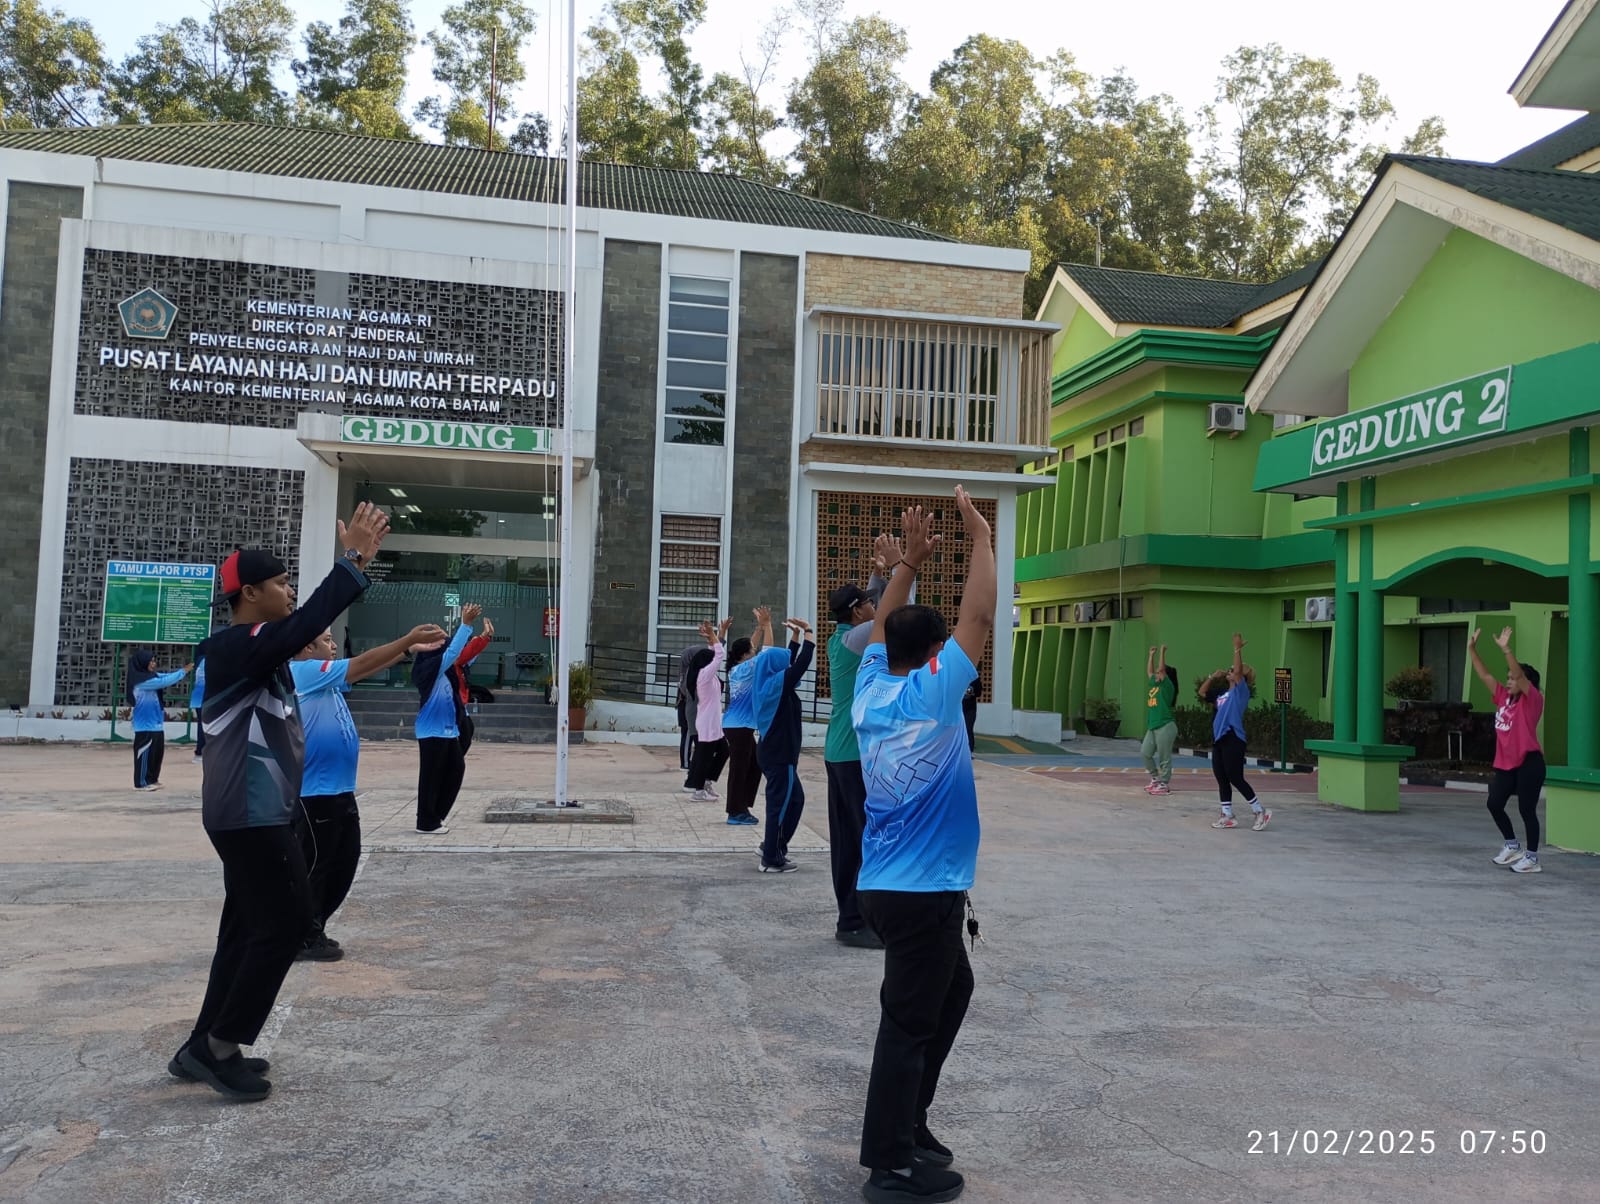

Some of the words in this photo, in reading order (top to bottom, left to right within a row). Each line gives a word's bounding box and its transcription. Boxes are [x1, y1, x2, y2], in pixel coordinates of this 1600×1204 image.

[247, 300, 352, 321] KEMENTERIAN
[358, 310, 412, 327] AGAMA
[417, 314, 432, 328] RI
[252, 319, 345, 338] DIREKTORAT
[351, 327, 425, 344] JENDERAL
[189, 332, 341, 356] PENYELENGGARAAN
[348, 345, 380, 360] HAJI
[387, 349, 417, 362] DAN
[423, 351, 475, 366] UMRAH
[100, 347, 171, 371] PUSAT
[175, 353, 274, 378] LAYANAN
[280, 361, 326, 382] HAJI
[331, 365, 373, 386] DAN
[379, 370, 452, 391] UMRAH
[457, 374, 556, 398] TERPADU
[170, 378, 235, 395] KANTOR
[242, 383, 346, 404] KEMENTERIAN
[353, 393, 405, 408] AGAMA
[411, 396, 447, 410] KOTA
[453, 399, 500, 413] BATAM
[343, 417, 516, 450] GEDUNG
[532, 429, 549, 451] 1
[1313, 390, 1466, 466] GEDUNG
[1478, 378, 1506, 426] 2
[113, 563, 143, 574] TAMU
[146, 565, 180, 575] LAPOR
[182, 566, 209, 577] PTSP
